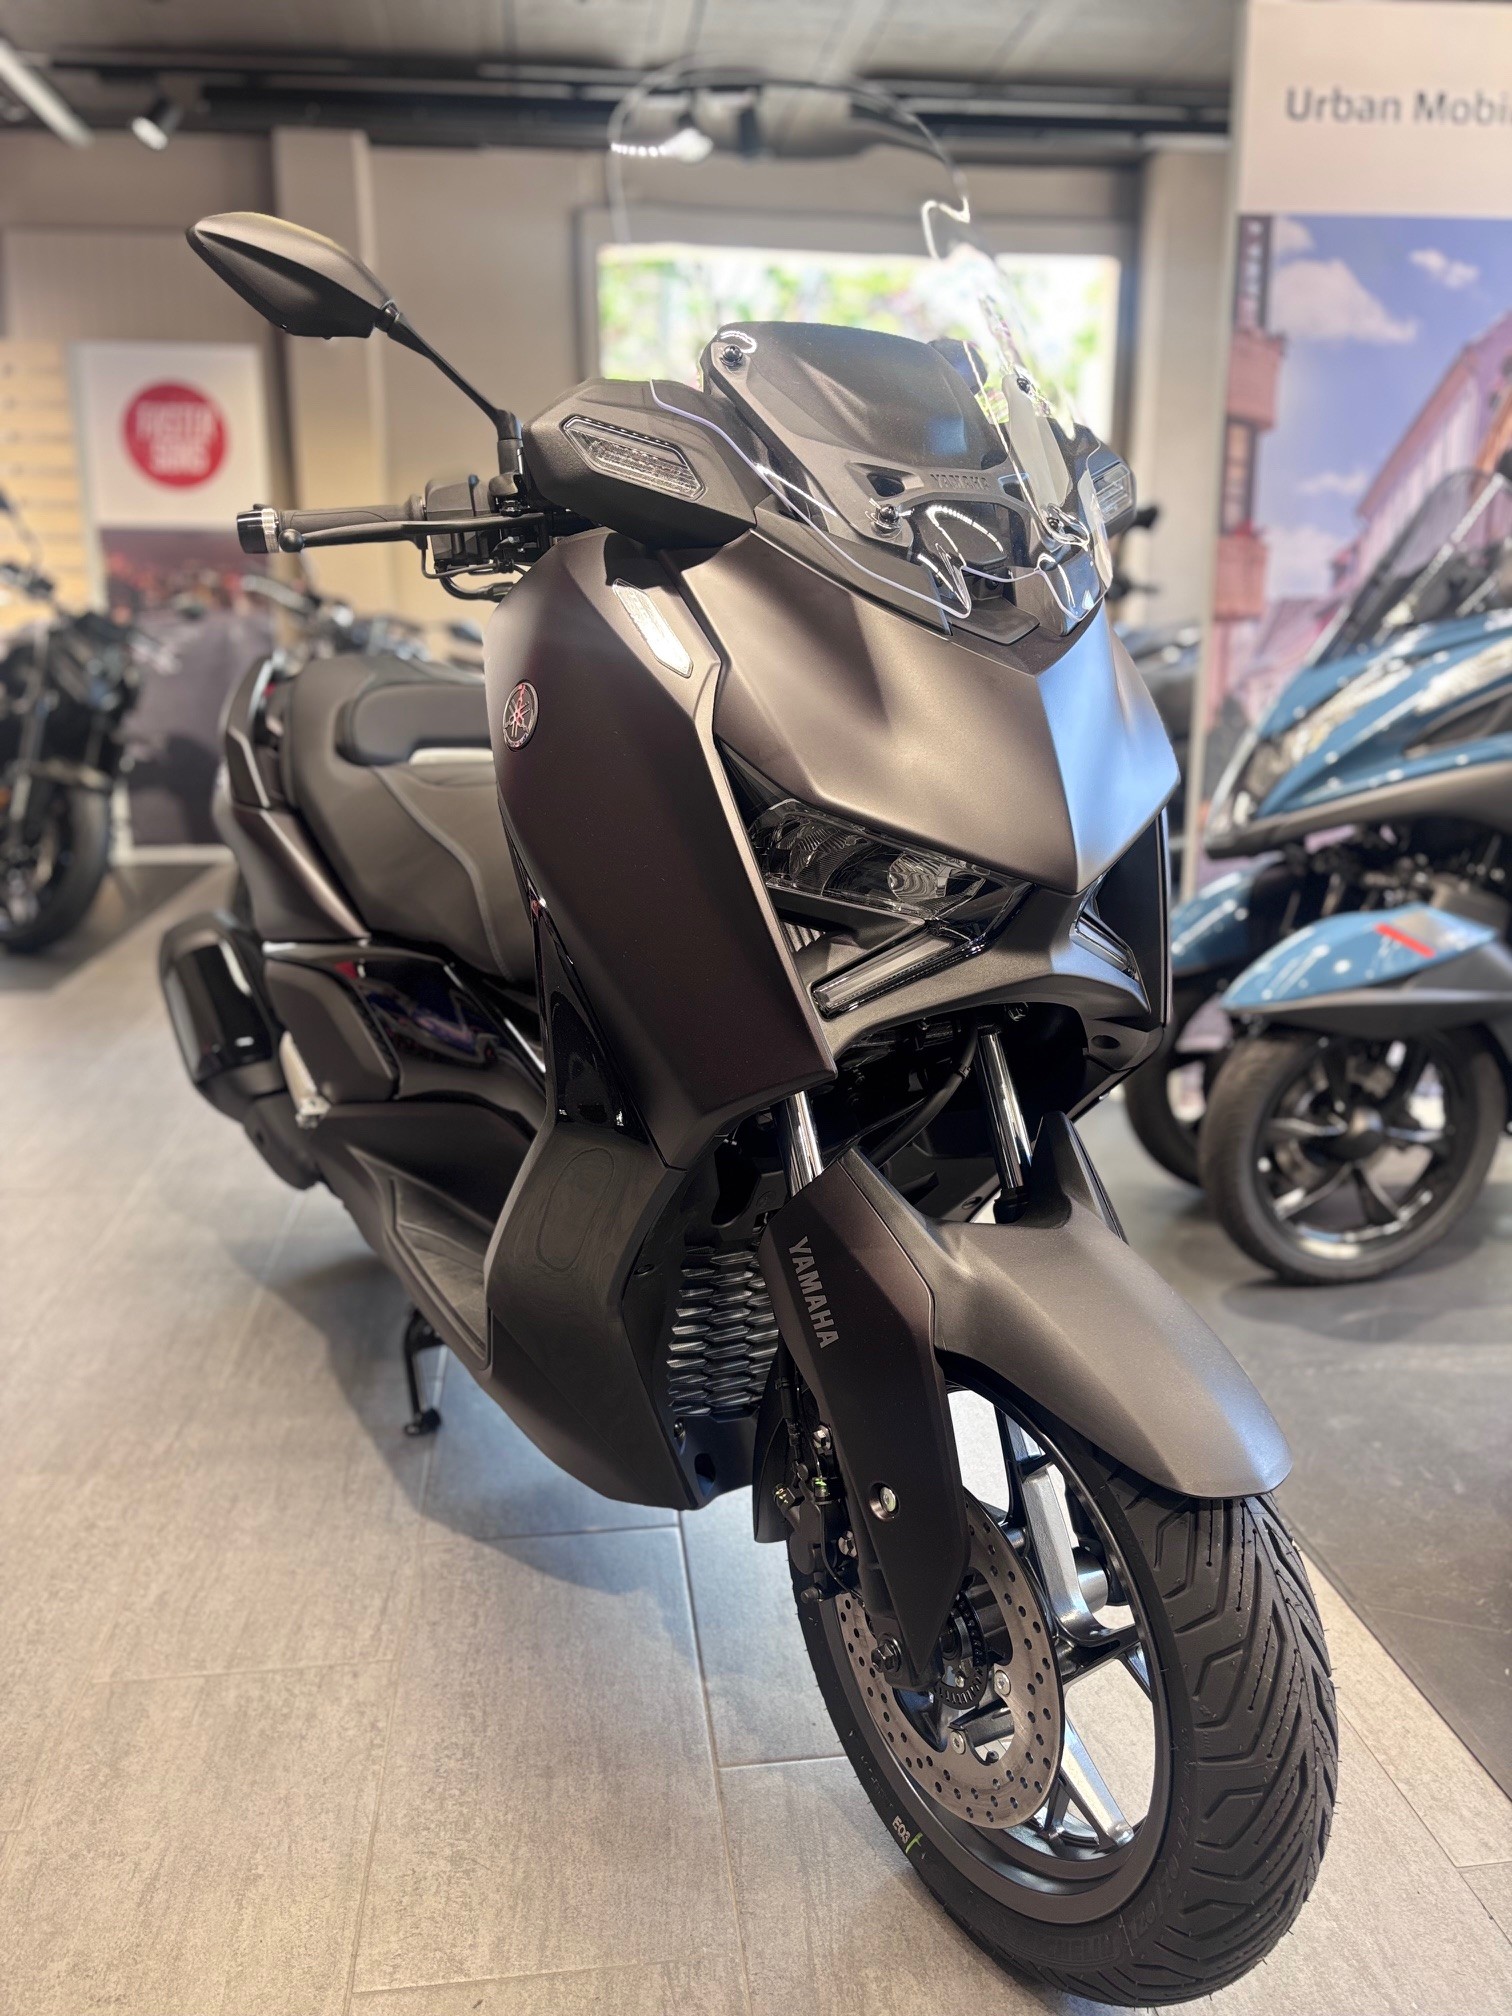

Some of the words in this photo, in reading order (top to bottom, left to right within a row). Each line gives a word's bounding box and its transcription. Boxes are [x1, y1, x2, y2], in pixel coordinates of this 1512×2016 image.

[1285, 86, 1401, 123] Urban
[1414, 88, 1512, 125] Mobi
[929, 473, 993, 491] YAMAHA
[788, 1236, 839, 1349] YAMAHA
